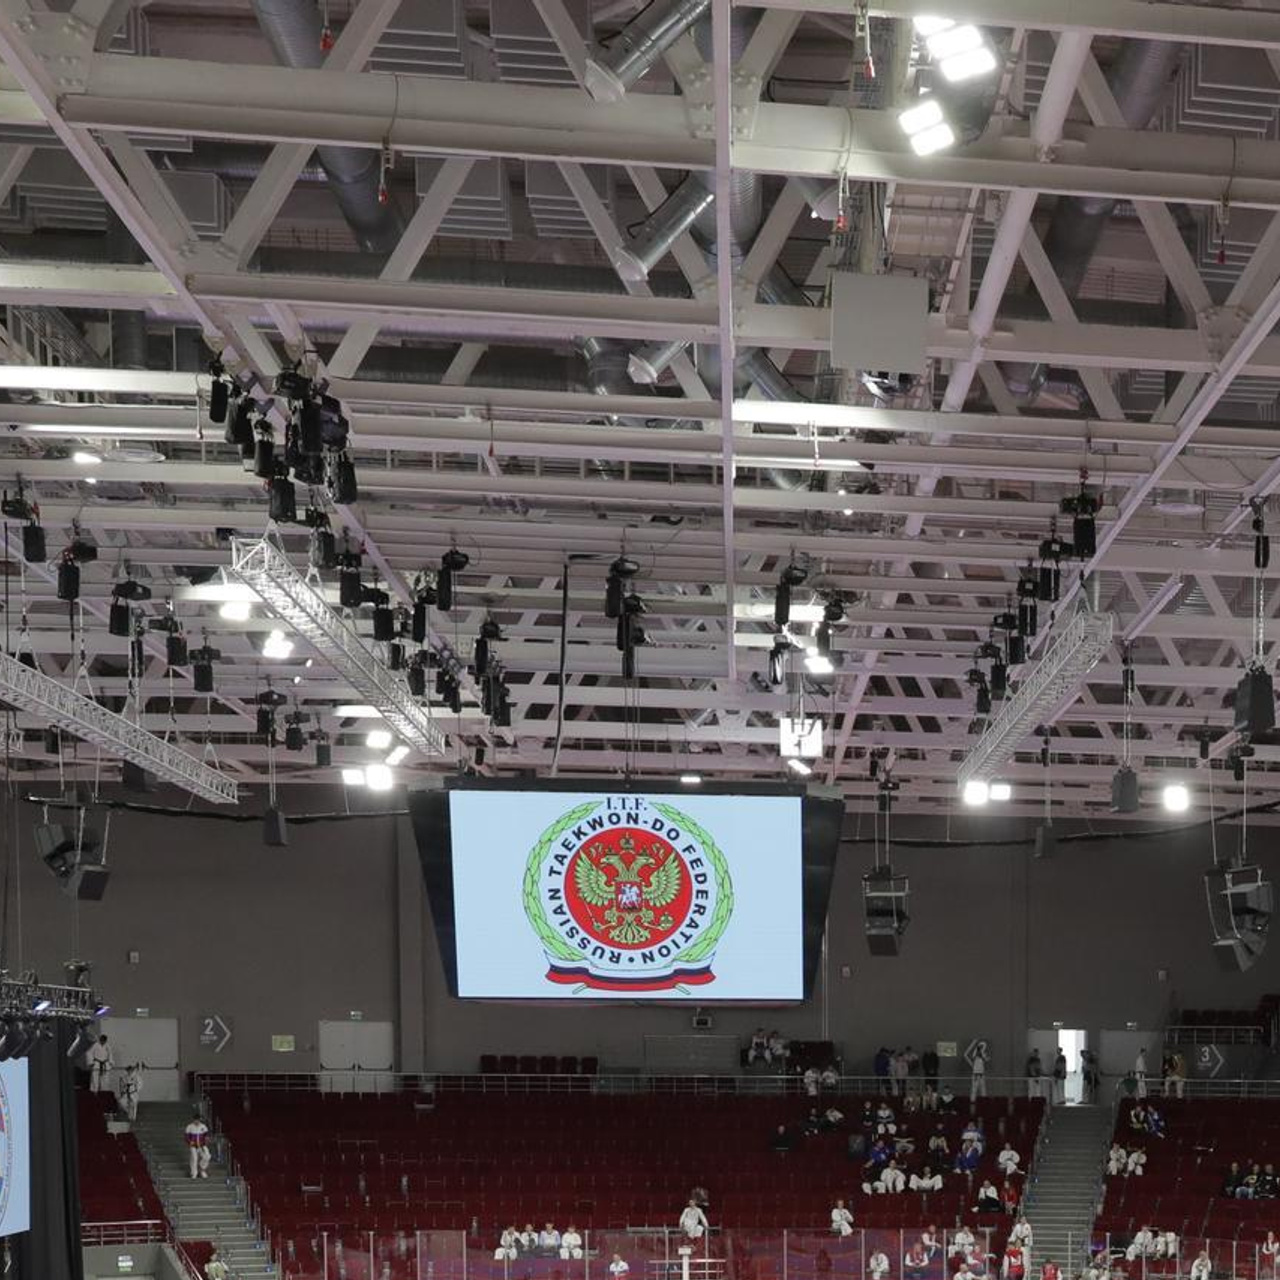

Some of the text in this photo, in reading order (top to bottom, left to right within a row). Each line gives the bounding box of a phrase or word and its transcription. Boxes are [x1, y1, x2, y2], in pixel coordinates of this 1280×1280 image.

[606, 797, 648, 811] I.T.F.
[548, 812, 708, 965] RUSSIAN TAEKWON-DO FEDERATION
[204, 1018, 214, 1035] 2
[1201, 1045, 1210, 1062] 3
